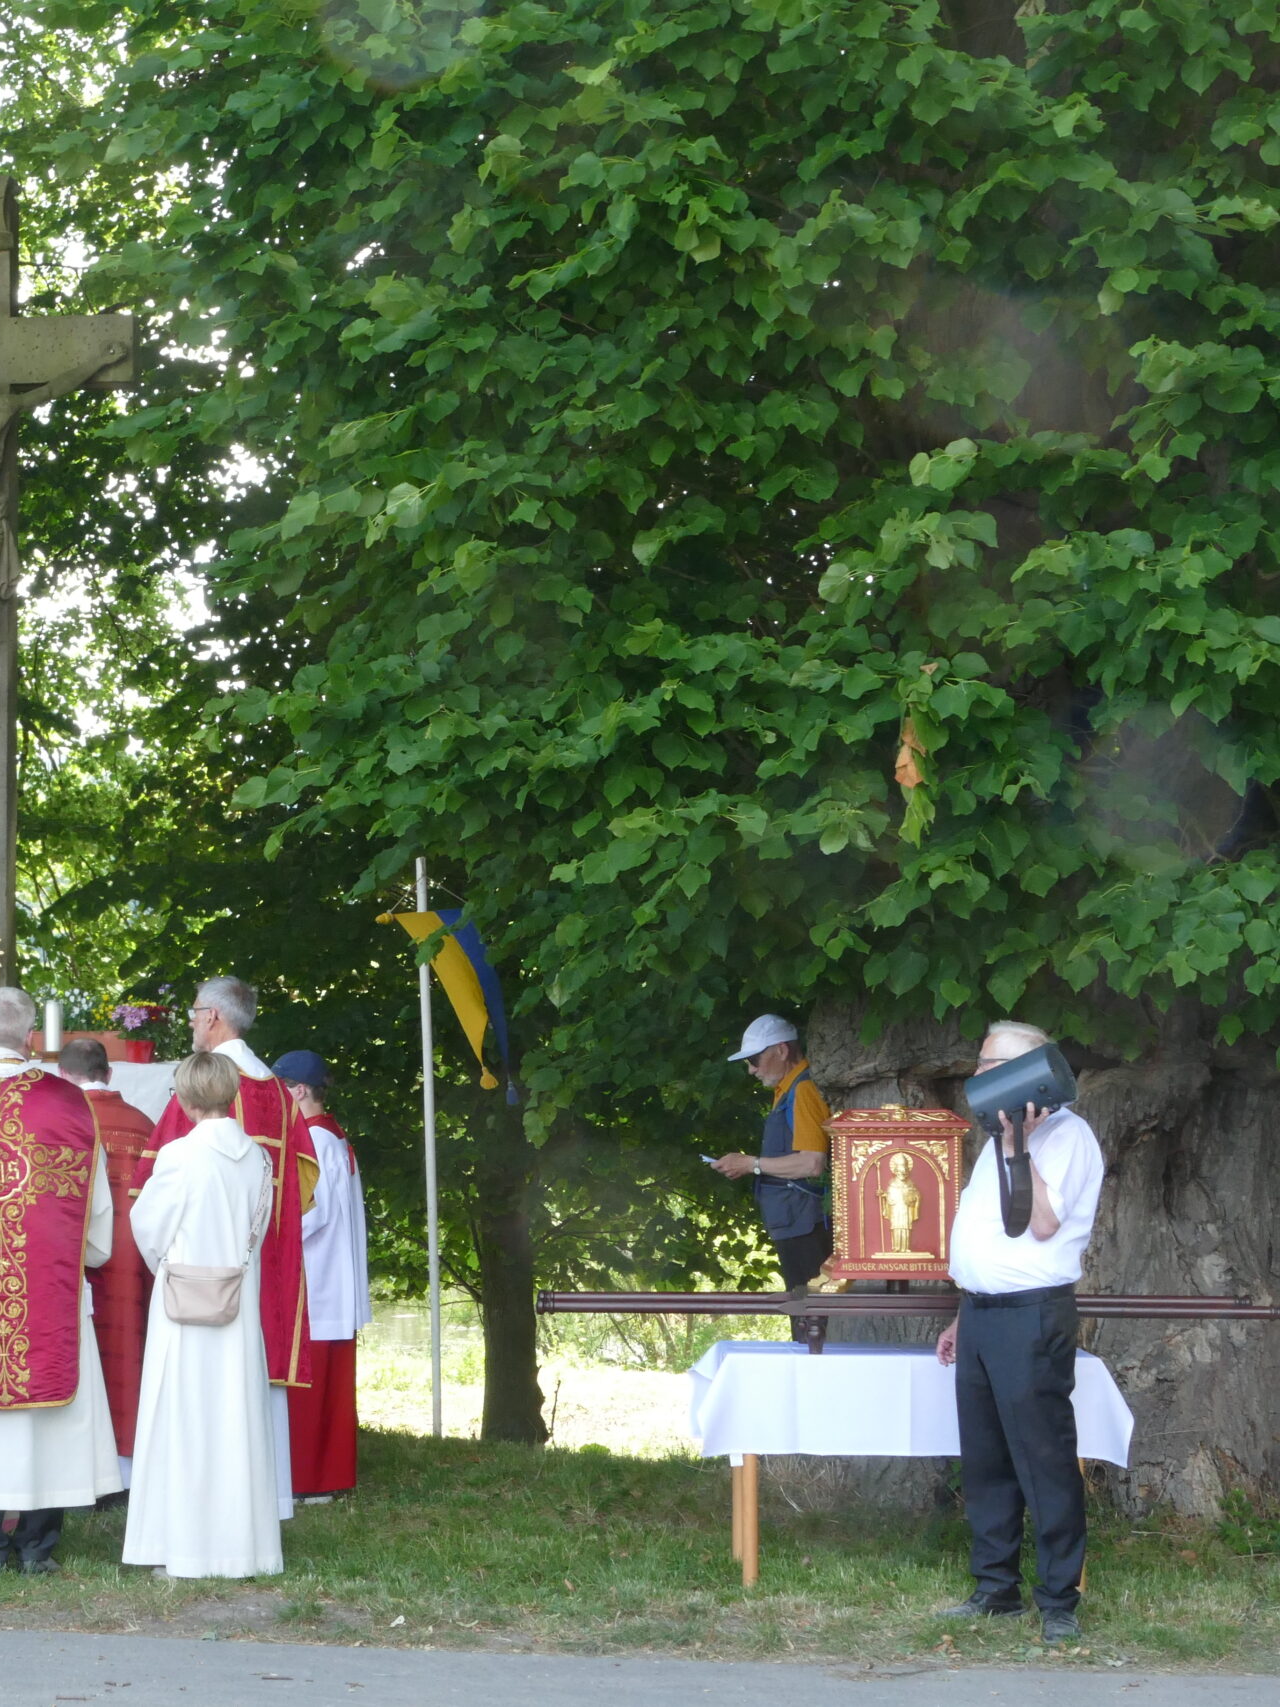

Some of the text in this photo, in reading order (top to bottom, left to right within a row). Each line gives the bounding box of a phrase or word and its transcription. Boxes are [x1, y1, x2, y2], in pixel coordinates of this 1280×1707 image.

[842, 1262, 876, 1272] HEILIGER
[878, 1262, 908, 1272] ANSGAR
[909, 1262, 932, 1272] BITTE
